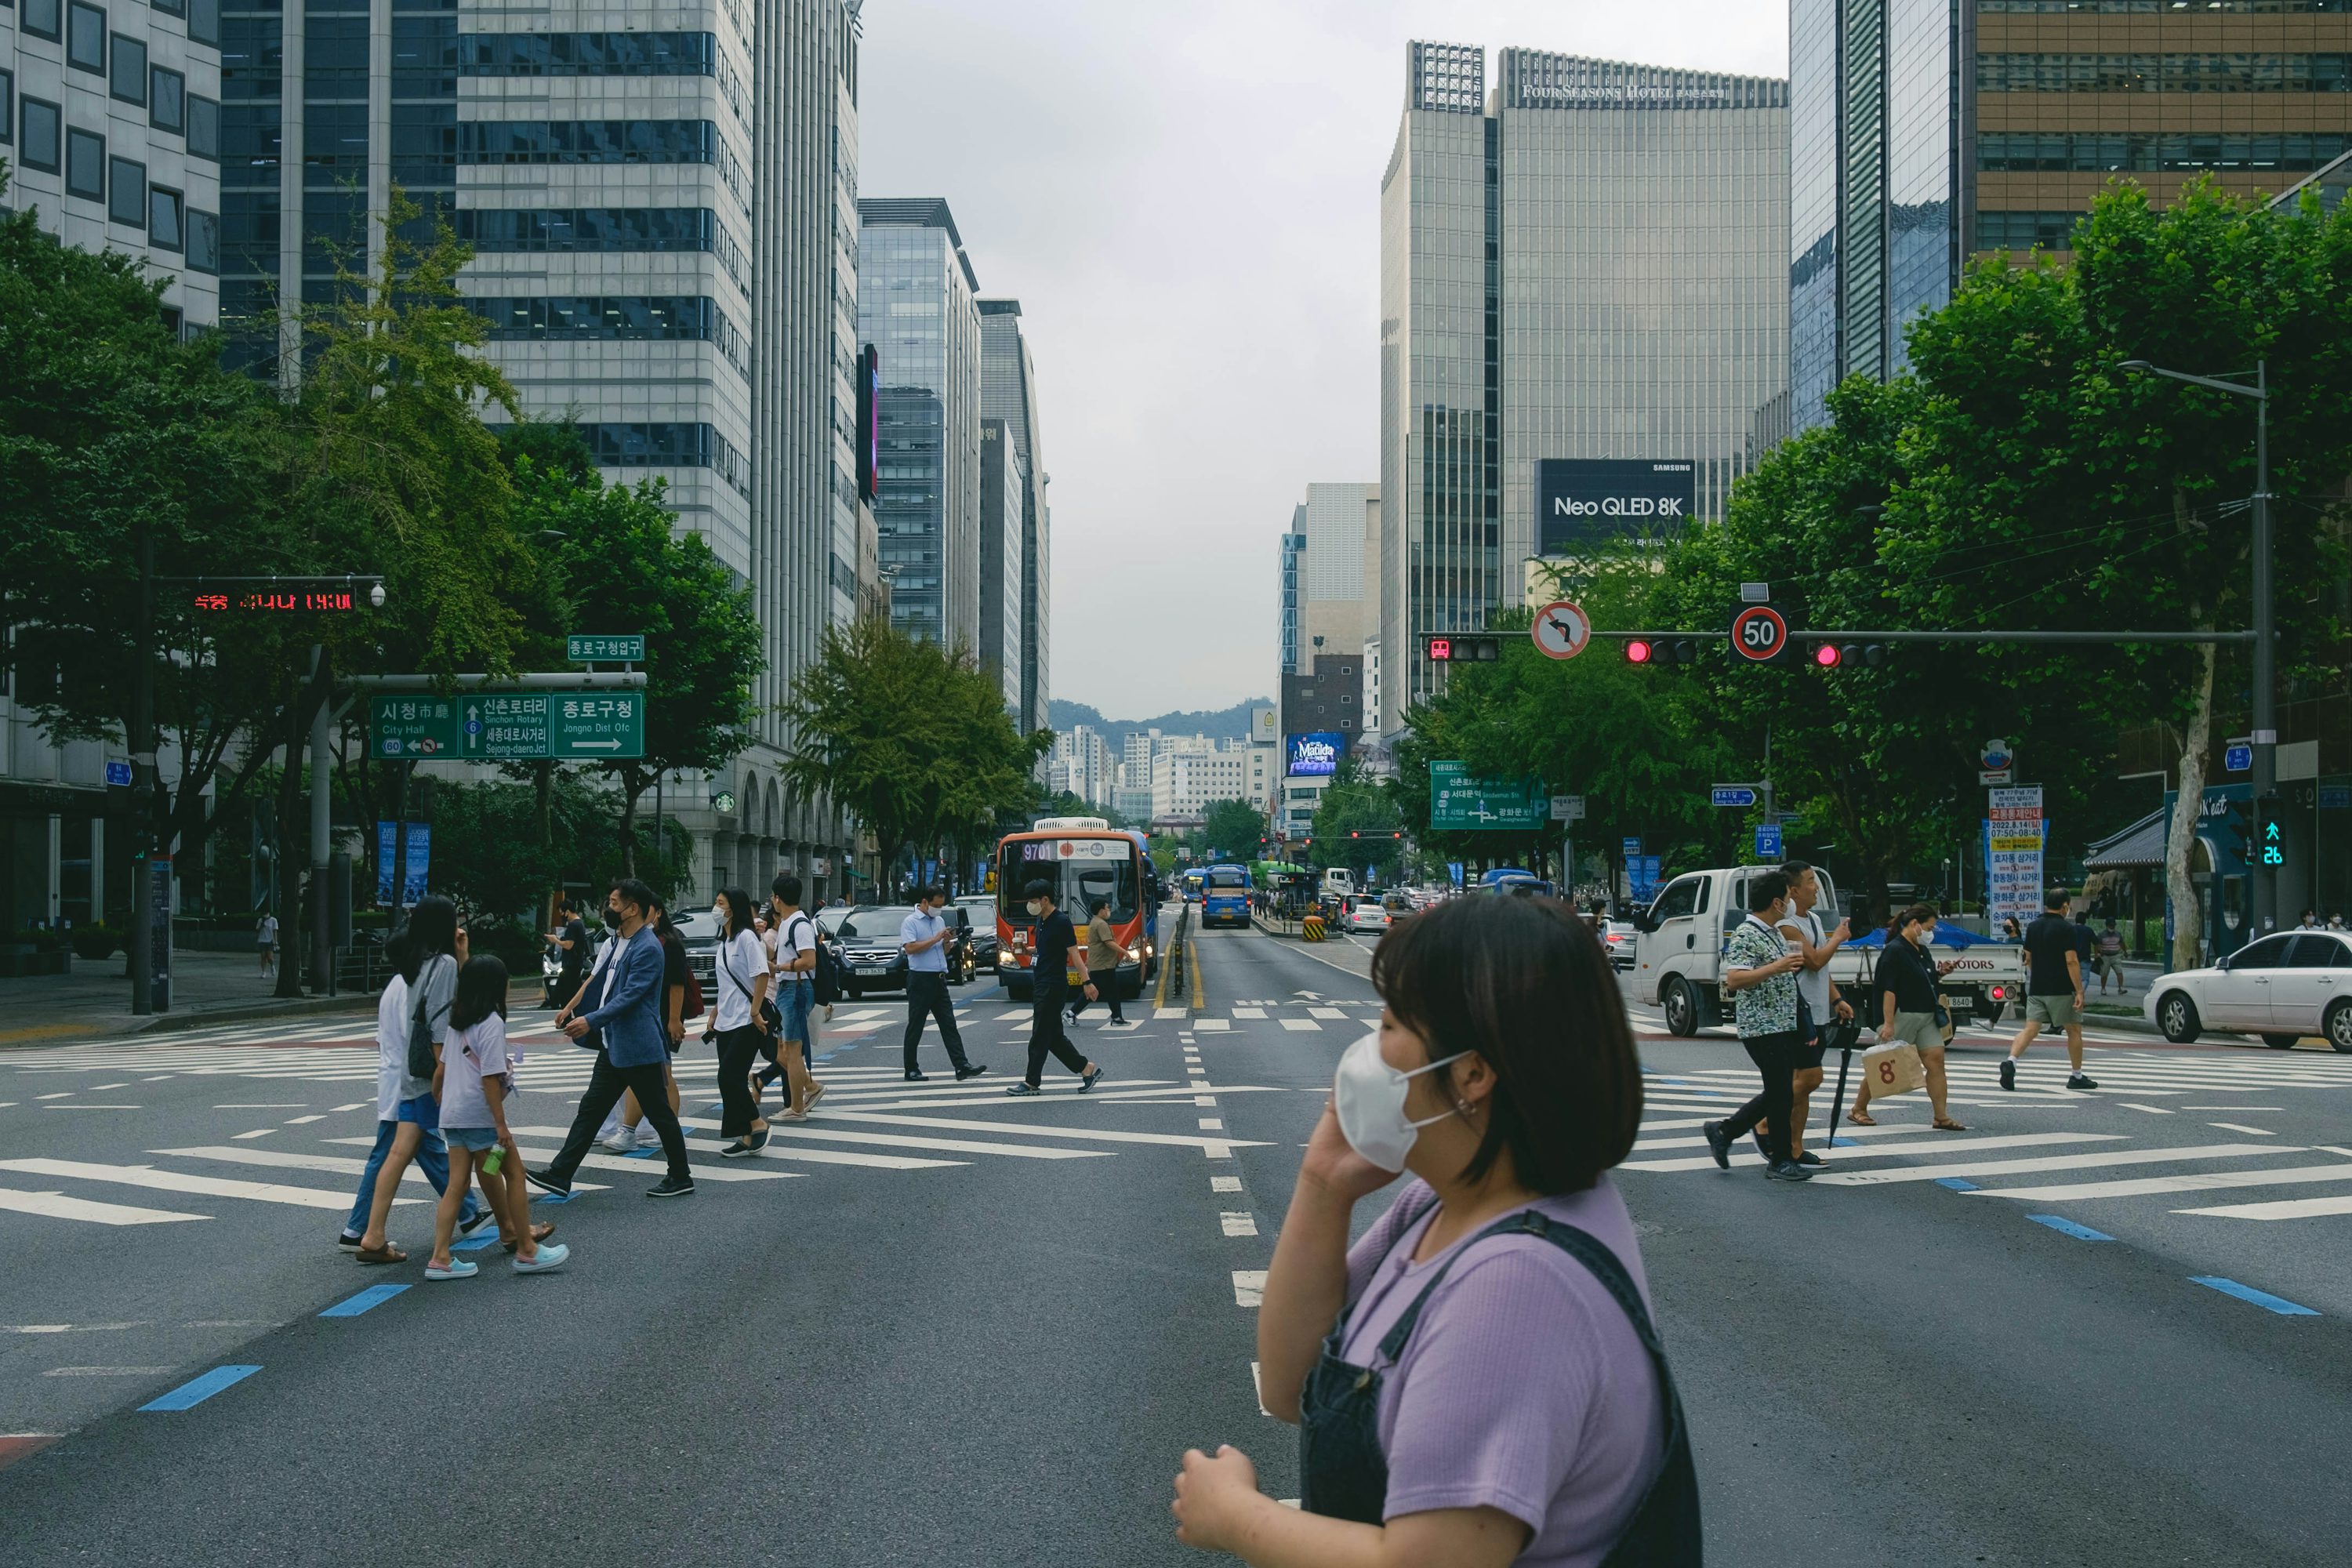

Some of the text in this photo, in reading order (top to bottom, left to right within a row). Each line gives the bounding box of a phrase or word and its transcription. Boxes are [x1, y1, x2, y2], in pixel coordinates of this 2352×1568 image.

[1522, 85, 1560, 98] FOUR
[1563, 85, 1622, 99] SEASONS
[1626, 84, 1674, 98] HOTEL
[1555, 497, 1683, 516] Neo QLED 8K
[1744, 621, 1775, 645] 50
[570, 641, 641, 655] 종로구청입구
[382, 702, 416, 720] 시청
[484, 698, 547, 715] 신촌로터리
[563, 700, 632, 719] 종로구청
[485, 715, 543, 725] Sinchon Rotary
[383, 725, 425, 736] City Hall
[470, 722, 477, 732] 6
[563, 723, 630, 735] Jongno Dist Ofc
[486, 727, 546, 742] 세종대로사거리
[387, 742, 400, 751] 60
[485, 743, 546, 756] Sejong-daero Jct
[1299, 742, 1334, 759] Matilda
[1498, 808, 1522, 817] 광화문
[1534, 800, 1548, 818] P
[1991, 808, 2042, 820] 교통통제안내
[1991, 829, 2042, 838] 07:50~08:40
[1763, 839, 1773, 850] P
[1024, 844, 1051, 862] 9701
[1994, 852, 2039, 863] 효자동 삼거리
[2263, 846, 2283, 864] 26
[1993, 873, 2040, 884] 합동청사 사거리
[1993, 892, 2040, 902] 광화문 삼거리
[1955, 960, 1994, 970] OTORS
[1951, 997, 1969, 1007] 8640
